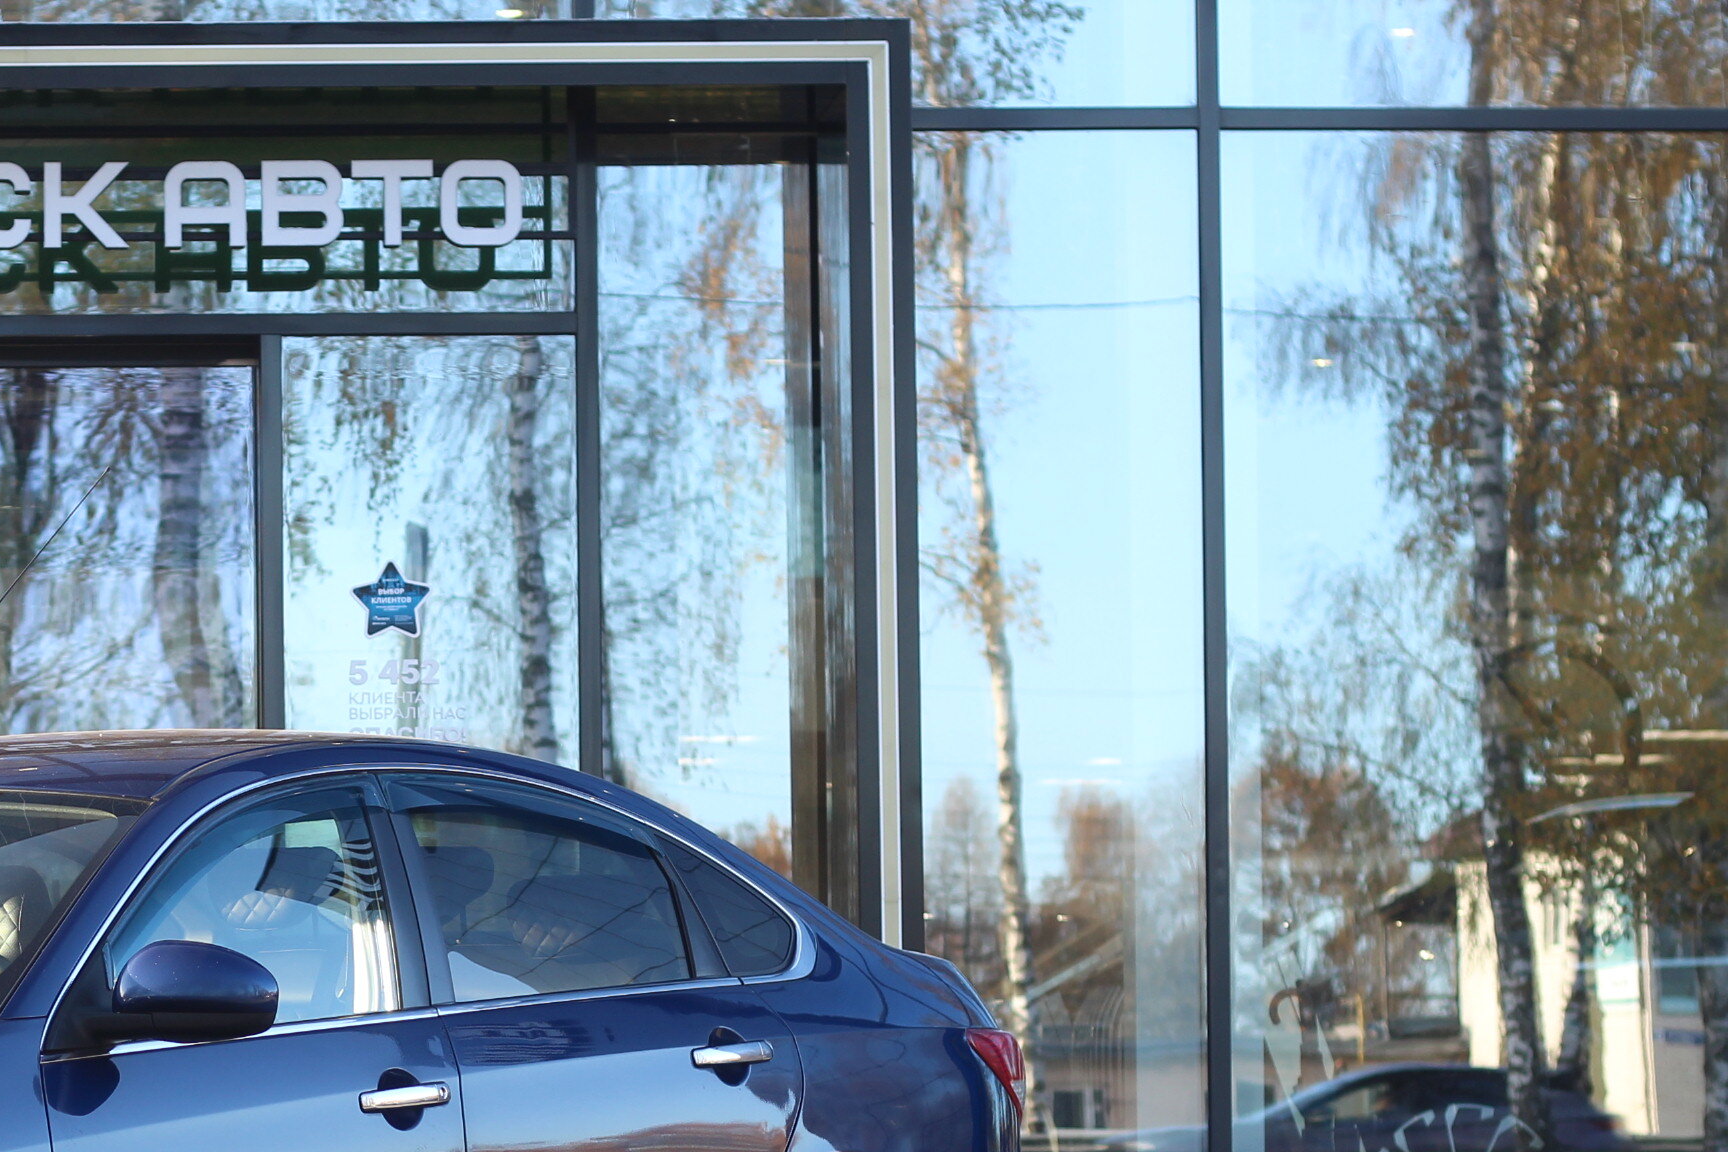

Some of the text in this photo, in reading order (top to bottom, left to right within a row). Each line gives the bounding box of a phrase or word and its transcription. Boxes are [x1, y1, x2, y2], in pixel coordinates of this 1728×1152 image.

[164, 160, 523, 247] АВТО
[377, 587, 405, 596] ВЫБОР
[371, 596, 412, 604] КЛИЕНТОВ
[348, 658, 440, 686] 5 452
[348, 691, 426, 706] КЛИЕНТА
[348, 706, 467, 721] ВЫБРАЛИ НАС
